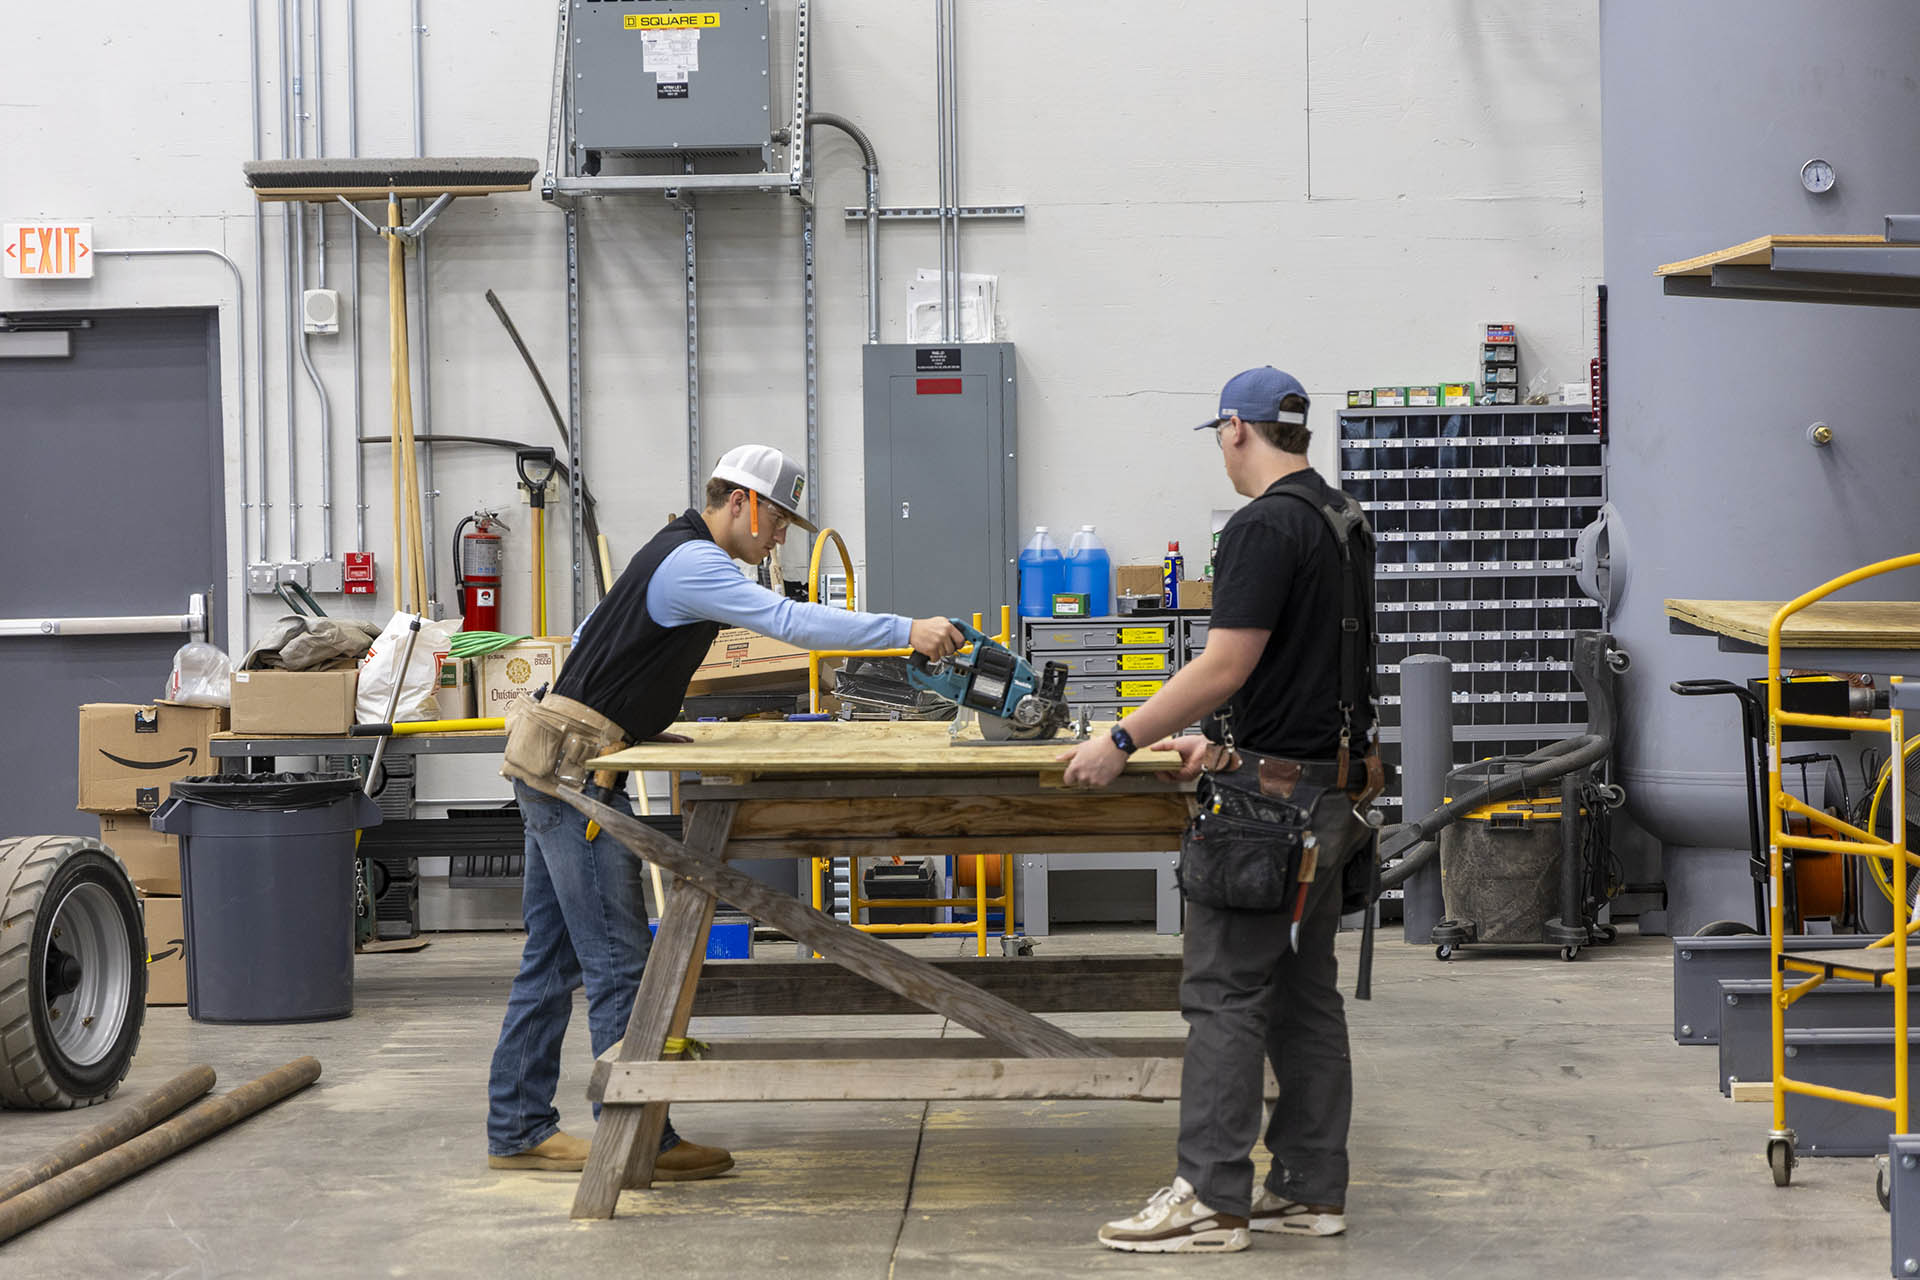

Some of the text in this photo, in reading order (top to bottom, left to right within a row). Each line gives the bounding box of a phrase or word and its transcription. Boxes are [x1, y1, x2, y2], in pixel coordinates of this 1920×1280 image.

[640, 16, 698, 26] SQUARE
[704, 15, 715, 25] D
[19, 227, 80, 273] EXIT
